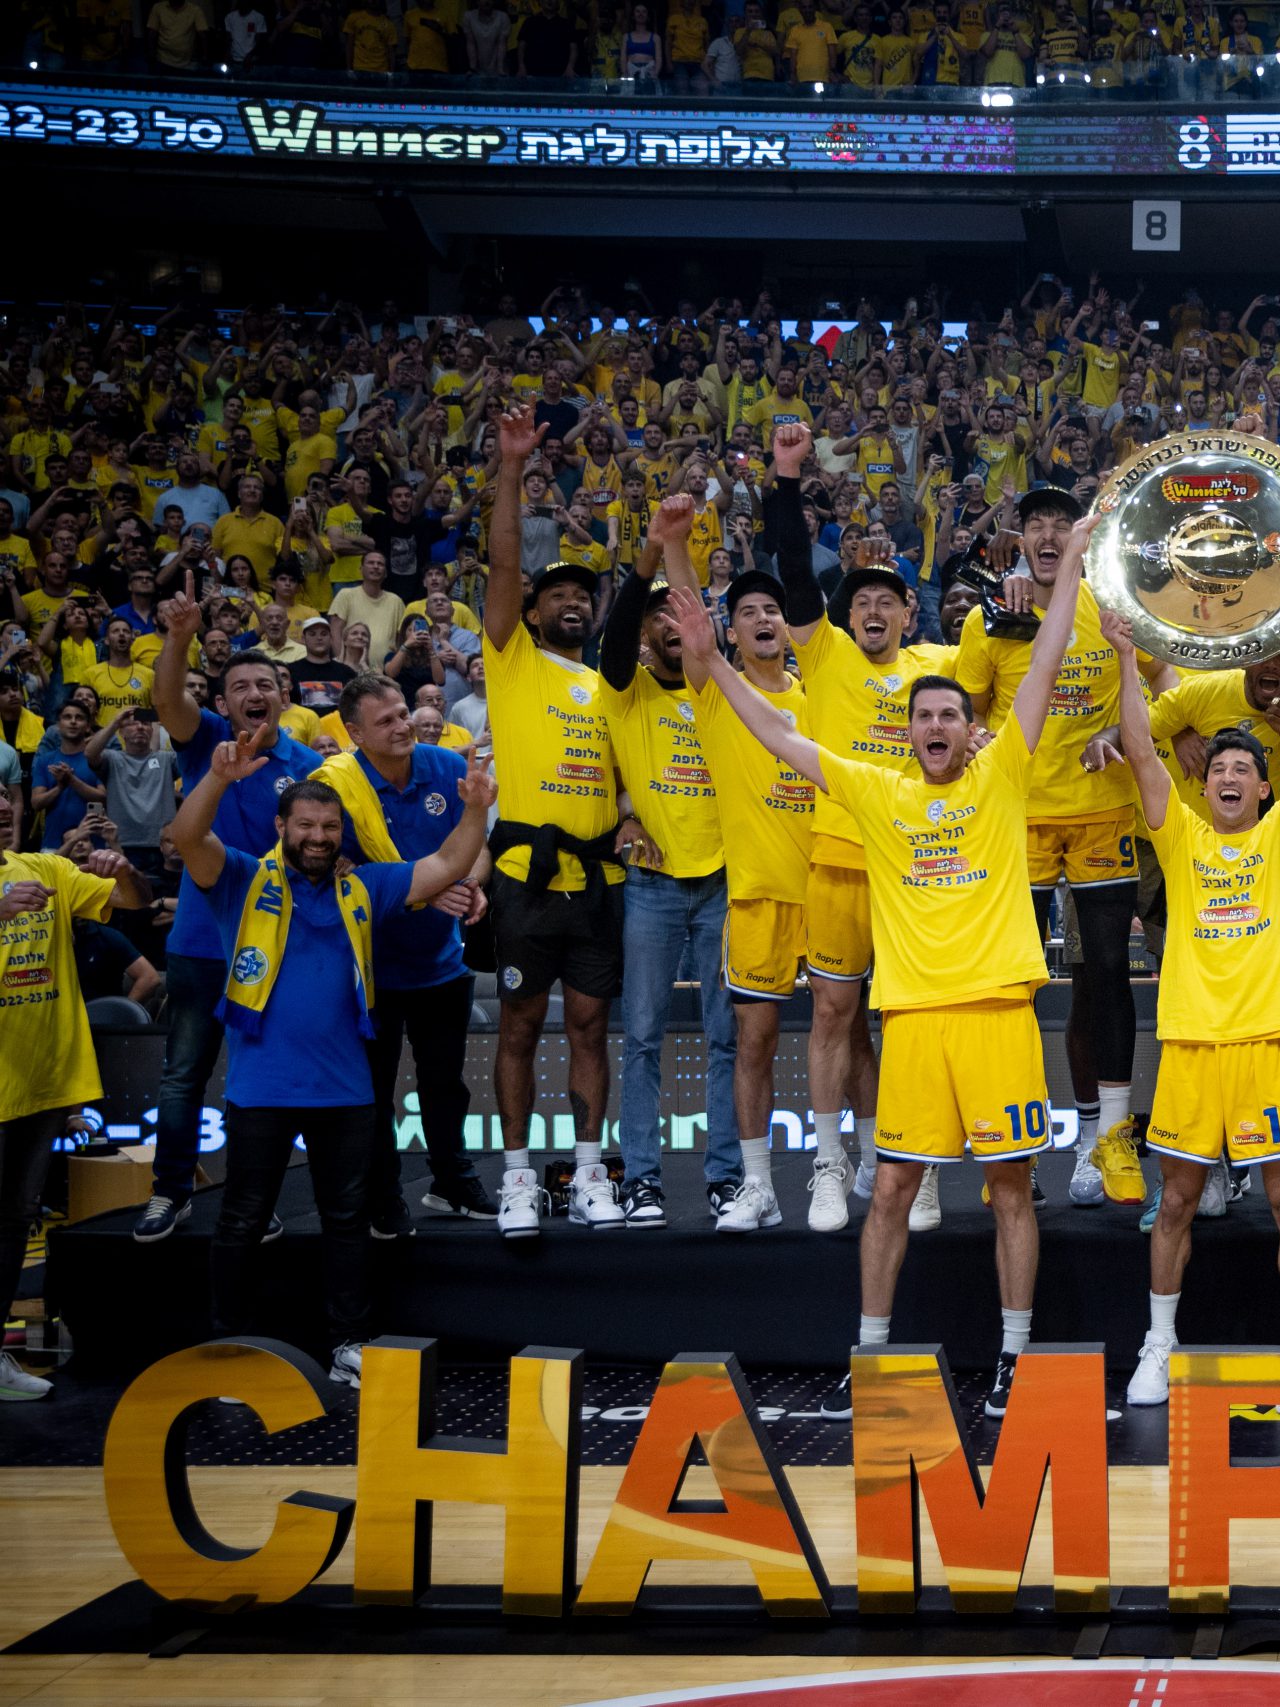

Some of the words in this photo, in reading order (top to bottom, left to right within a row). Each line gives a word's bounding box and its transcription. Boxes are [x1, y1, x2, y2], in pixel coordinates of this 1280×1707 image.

[155, 110, 223, 148] סל
[244, 105, 500, 160] Winner
[520, 126, 627, 162] ליגת
[636, 129, 786, 165] אלופת
[1179, 120, 1211, 170] 8
[1146, 209, 1168, 241] 8
[774, 415, 799, 424] FOX
[1187, 438, 1247, 454] ישראל
[868, 464, 892, 473] FOX
[1115, 443, 1185, 491] בכדורסל
[1172, 482, 1232, 499] Winner
[1210, 478, 1232, 490] ליגת
[1085, 647, 1114, 662] מכבי
[1168, 639, 1265, 661] 2022-2023
[1084, 665, 1103, 678] תל
[547, 705, 595, 724] Playtika
[874, 699, 907, 716] אביב
[562, 726, 593, 740] אביב
[873, 728, 908, 740] Winner
[564, 747, 602, 760] אלופת
[851, 741, 905, 757] 2022-23
[671, 754, 703, 766] לופת
[561, 766, 595, 778] Winner
[668, 769, 704, 781] Winner
[540, 780, 590, 797] 2022-23
[649, 780, 699, 797] 2022-23
[776, 786, 807, 799] Winner
[765, 796, 806, 813] 022-23
[942, 805, 977, 822] מכבי
[907, 832, 941, 846] אביב
[942, 826, 965, 840] תל
[913, 846, 959, 859] אלופת
[1119, 835, 1135, 868] 9
[915, 865, 952, 876] Winner
[1193, 858, 1228, 876] Playtik
[901, 875, 952, 887] 2022-23
[956, 868, 988, 885] עונת
[1201, 877, 1232, 889] אביב
[1235, 873, 1255, 887] תל
[1204, 912, 1243, 922] Winner
[1, 932, 30, 945] אביב
[31, 928, 49, 941] תל
[1193, 927, 1242, 939] 2022-23
[8, 951, 46, 966] אלופת
[815, 951, 844, 966] Rapyd
[8, 975, 41, 985] Winner
[745, 971, 776, 984] Rapyd
[0, 992, 43, 1007] 022-23
[1004, 1100, 1045, 1142] 10
[879, 1129, 903, 1141] Rapyd
[1151, 1125, 1179, 1140] Rapyd
